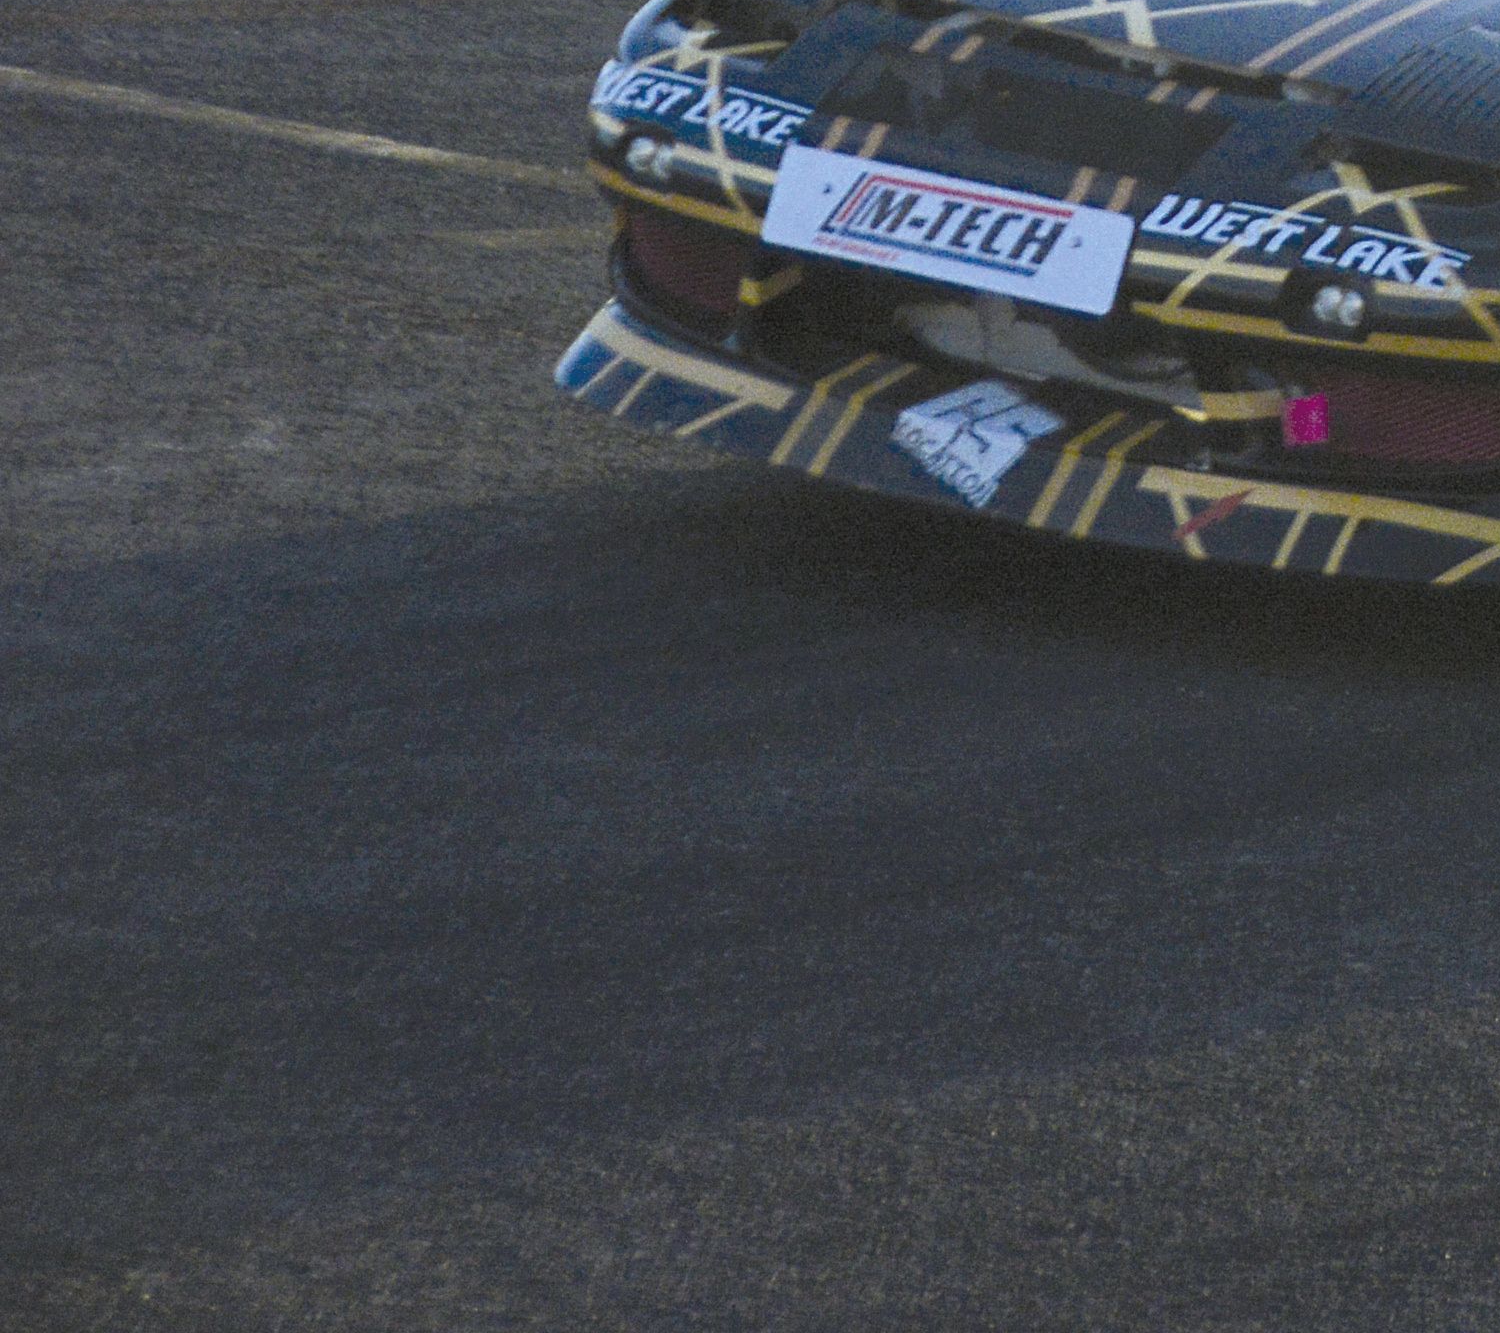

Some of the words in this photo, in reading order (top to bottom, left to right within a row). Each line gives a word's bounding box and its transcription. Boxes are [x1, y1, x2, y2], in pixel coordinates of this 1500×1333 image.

[680, 85, 812, 147] LAKE
[865, 188, 1069, 265] M-TECH
[1139, 192, 1311, 255] WEST
[1301, 223, 1468, 289] LAKE
